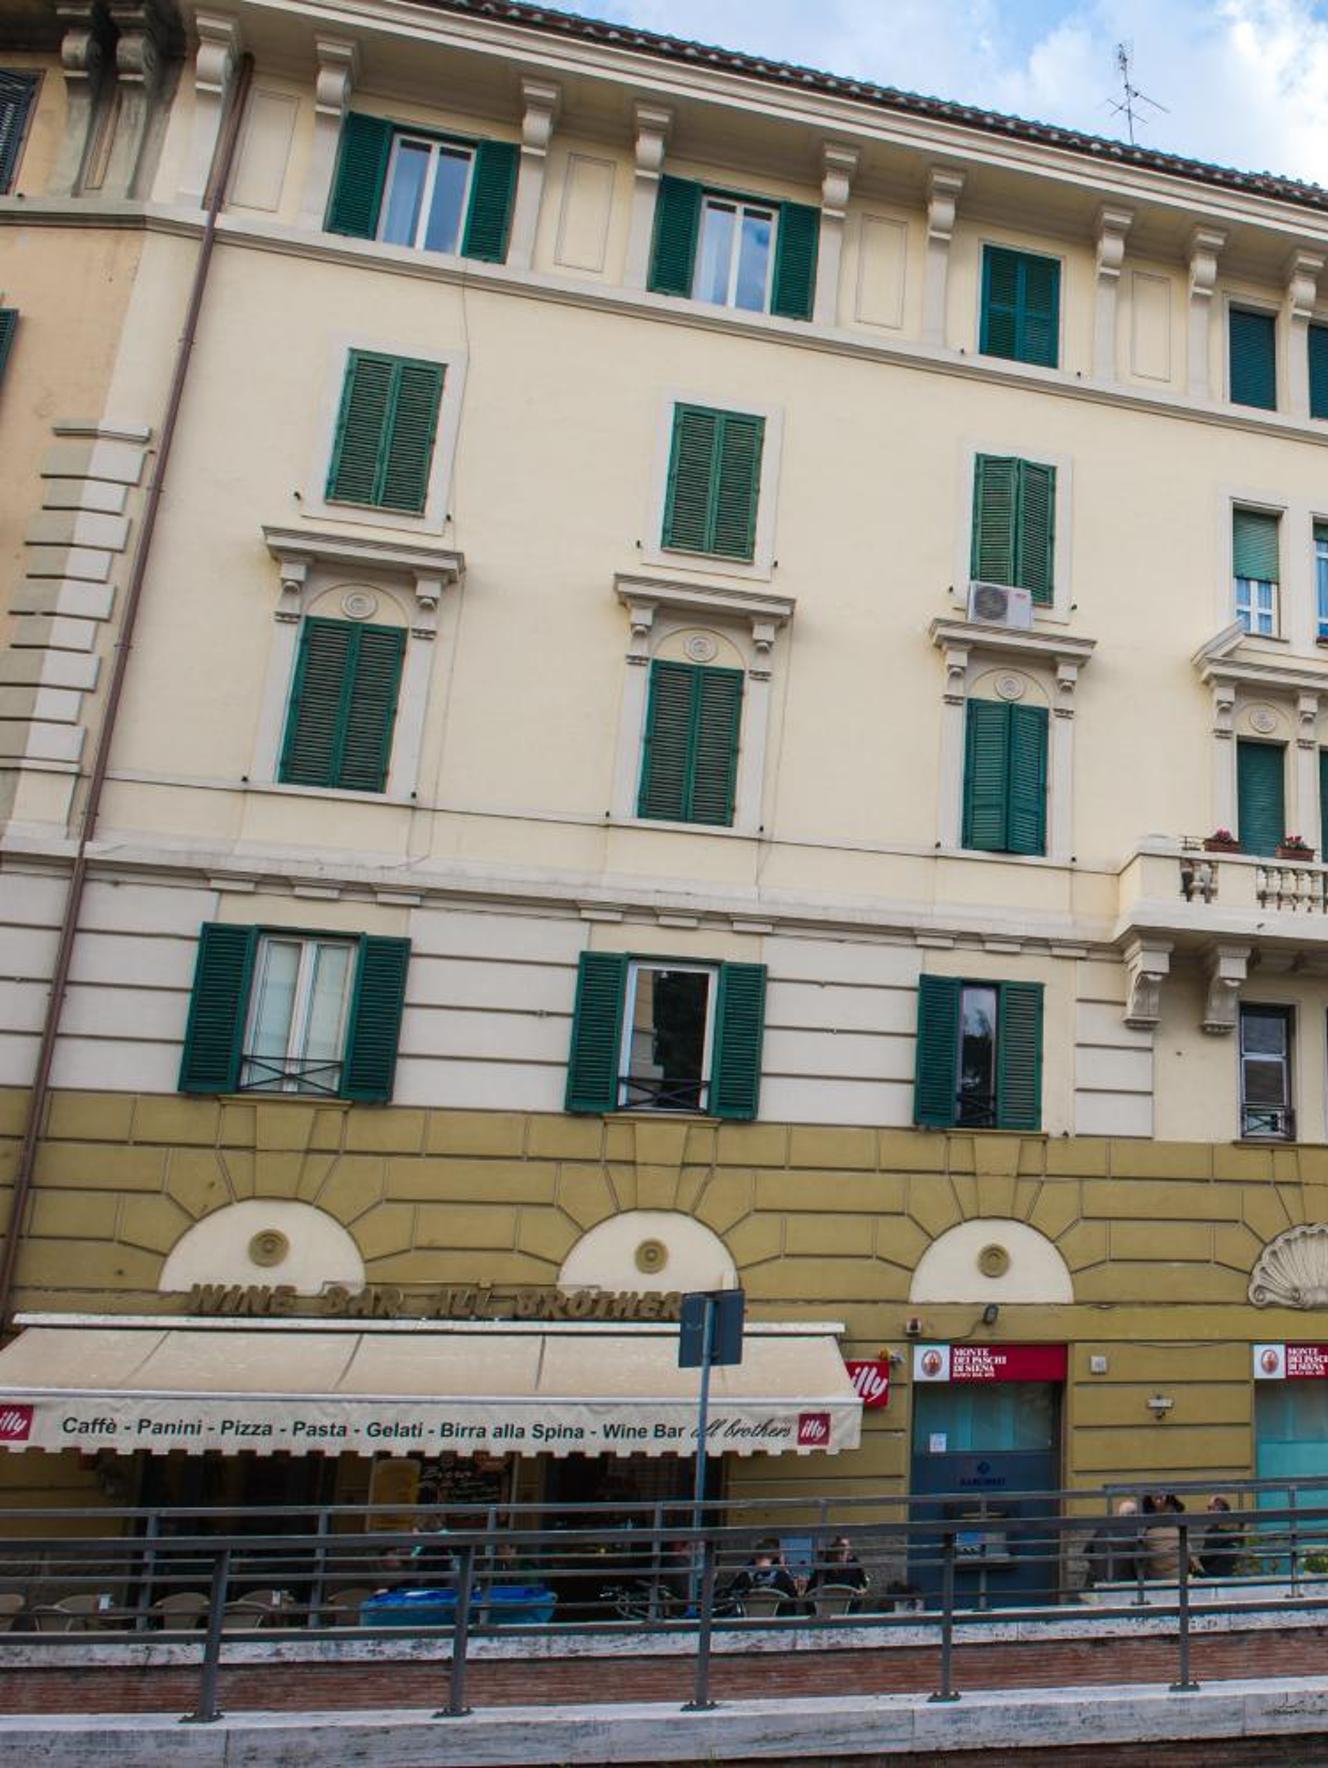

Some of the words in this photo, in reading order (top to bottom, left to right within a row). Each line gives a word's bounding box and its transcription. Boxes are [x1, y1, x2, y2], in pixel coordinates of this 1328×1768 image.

[190, 1283, 298, 1314] WINE
[851, 1366, 888, 1402] illy
[62, 1416, 117, 1434] Caffè
[137, 1417, 202, 1435] Panini
[220, 1419, 273, 1437] Pizza
[292, 1421, 347, 1437] Pasta
[366, 1421, 424, 1438] Gelati
[440, 1422, 487, 1438] Birra
[492, 1423, 525, 1439] alla
[531, 1423, 585, 1442] Spina
[603, 1424, 648, 1439] Wine
[653, 1423, 685, 1439] Bar
[723, 1418, 792, 1439] brothers
[801, 1419, 827, 1441] illy
